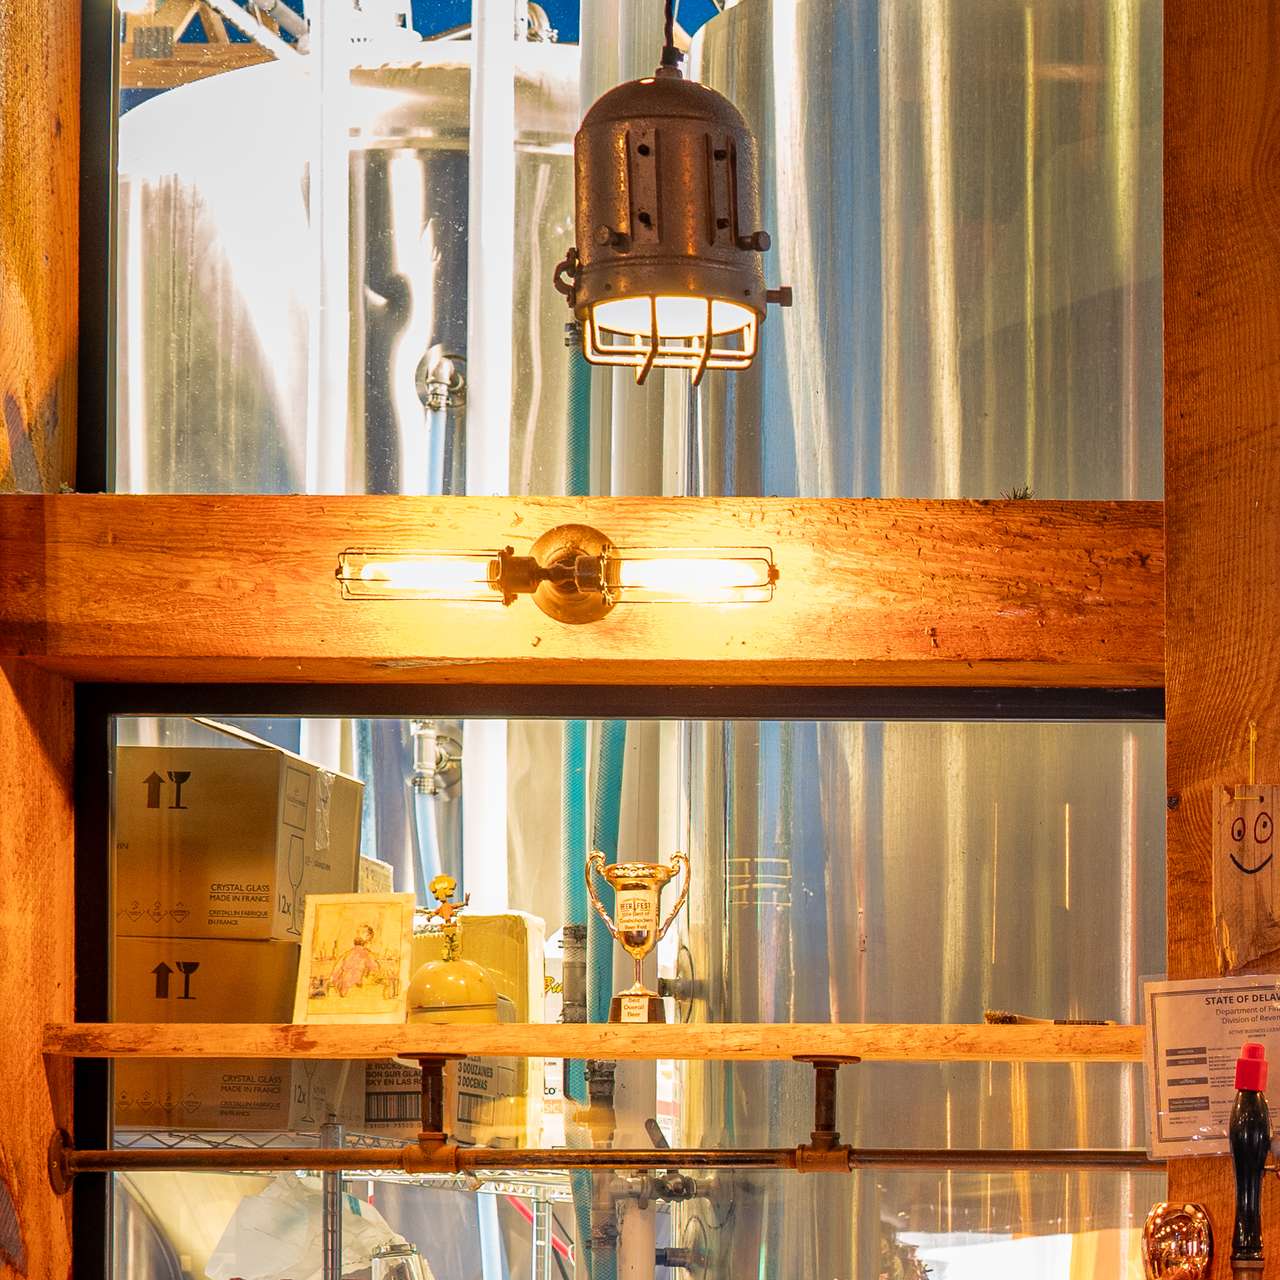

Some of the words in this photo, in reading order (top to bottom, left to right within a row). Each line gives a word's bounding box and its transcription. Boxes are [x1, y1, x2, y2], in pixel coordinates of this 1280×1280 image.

[1205, 997, 1233, 1006] STATE
[1237, 995, 1249, 1004] OF
[1216, 1006, 1258, 1016] Department
[1222, 1016, 1249, 1025] Division
[458, 1062, 462, 1071] 3
[463, 1063, 493, 1078] DOUZAINES
[223, 1075, 255, 1083] CRYSTAL
[457, 1076, 461, 1085] 3
[462, 1077, 487, 1090] DOCENAS
